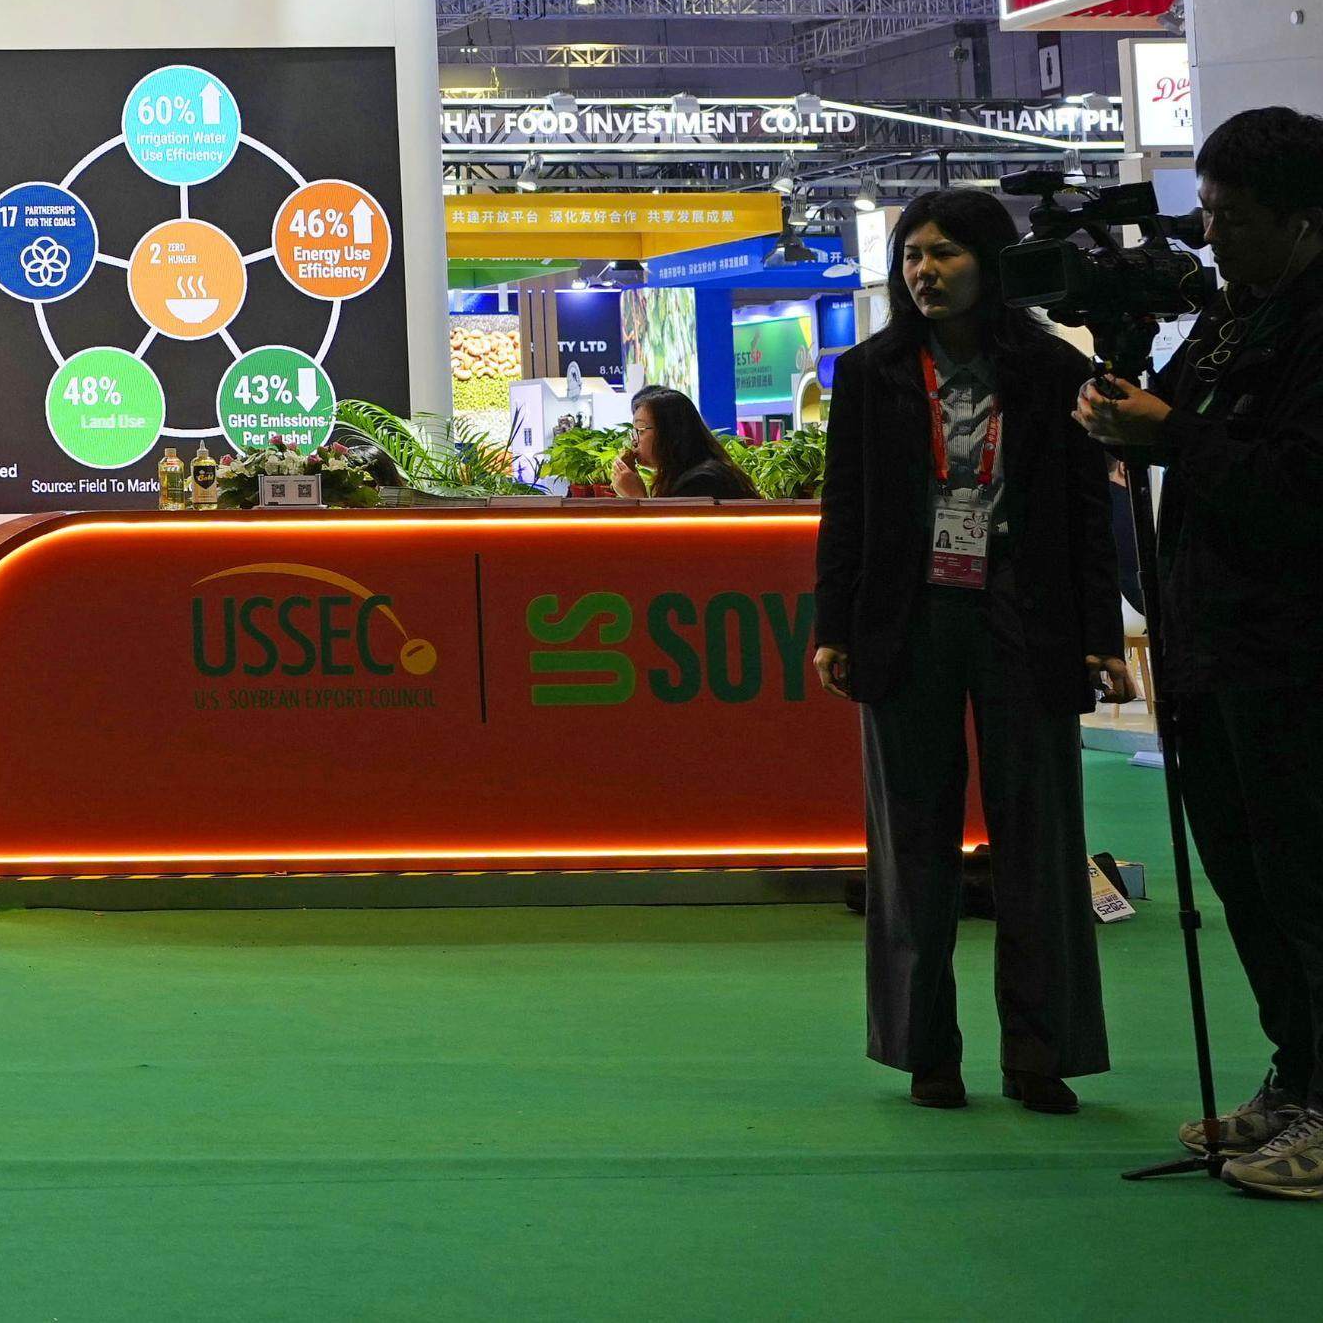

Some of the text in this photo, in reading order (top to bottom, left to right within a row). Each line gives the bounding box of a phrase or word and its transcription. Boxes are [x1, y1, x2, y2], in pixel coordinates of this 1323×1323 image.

[137, 95, 196, 126] 60%
[504, 111, 579, 135] FOOD
[585, 110, 754, 135] INVESTMENT
[136, 131, 228, 148] Irrigation Water
[141, 147, 225, 165] Use Efficiency
[24, 205, 76, 216] PARTNERSHIPS
[451, 210, 736, 224] 共建开放平台 深化友好合作 共享发展成果
[24, 217, 76, 228] FOR THE GOALS
[288, 208, 349, 239] 46%
[149, 243, 162, 265] 2
[167, 243, 186, 253] ZERO
[292, 246, 372, 265] Energy Use
[167, 254, 198, 265] HUNGER
[297, 263, 367, 282] Efficiency
[579, 340, 608, 353] LTD
[62, 376, 123, 406] 48%
[233, 374, 293, 405] 43%
[80, 414, 146, 429] Land Use
[228, 413, 328, 429] GHG Emissions
[243, 431, 266, 445] Per
[31, 478, 125, 494] Source: Field To
[191, 594, 395, 676] USSEC
[646, 592, 817, 704] SOY
[194, 687, 436, 711] U.S. SOYBEAN EXPORT COUNCIL
